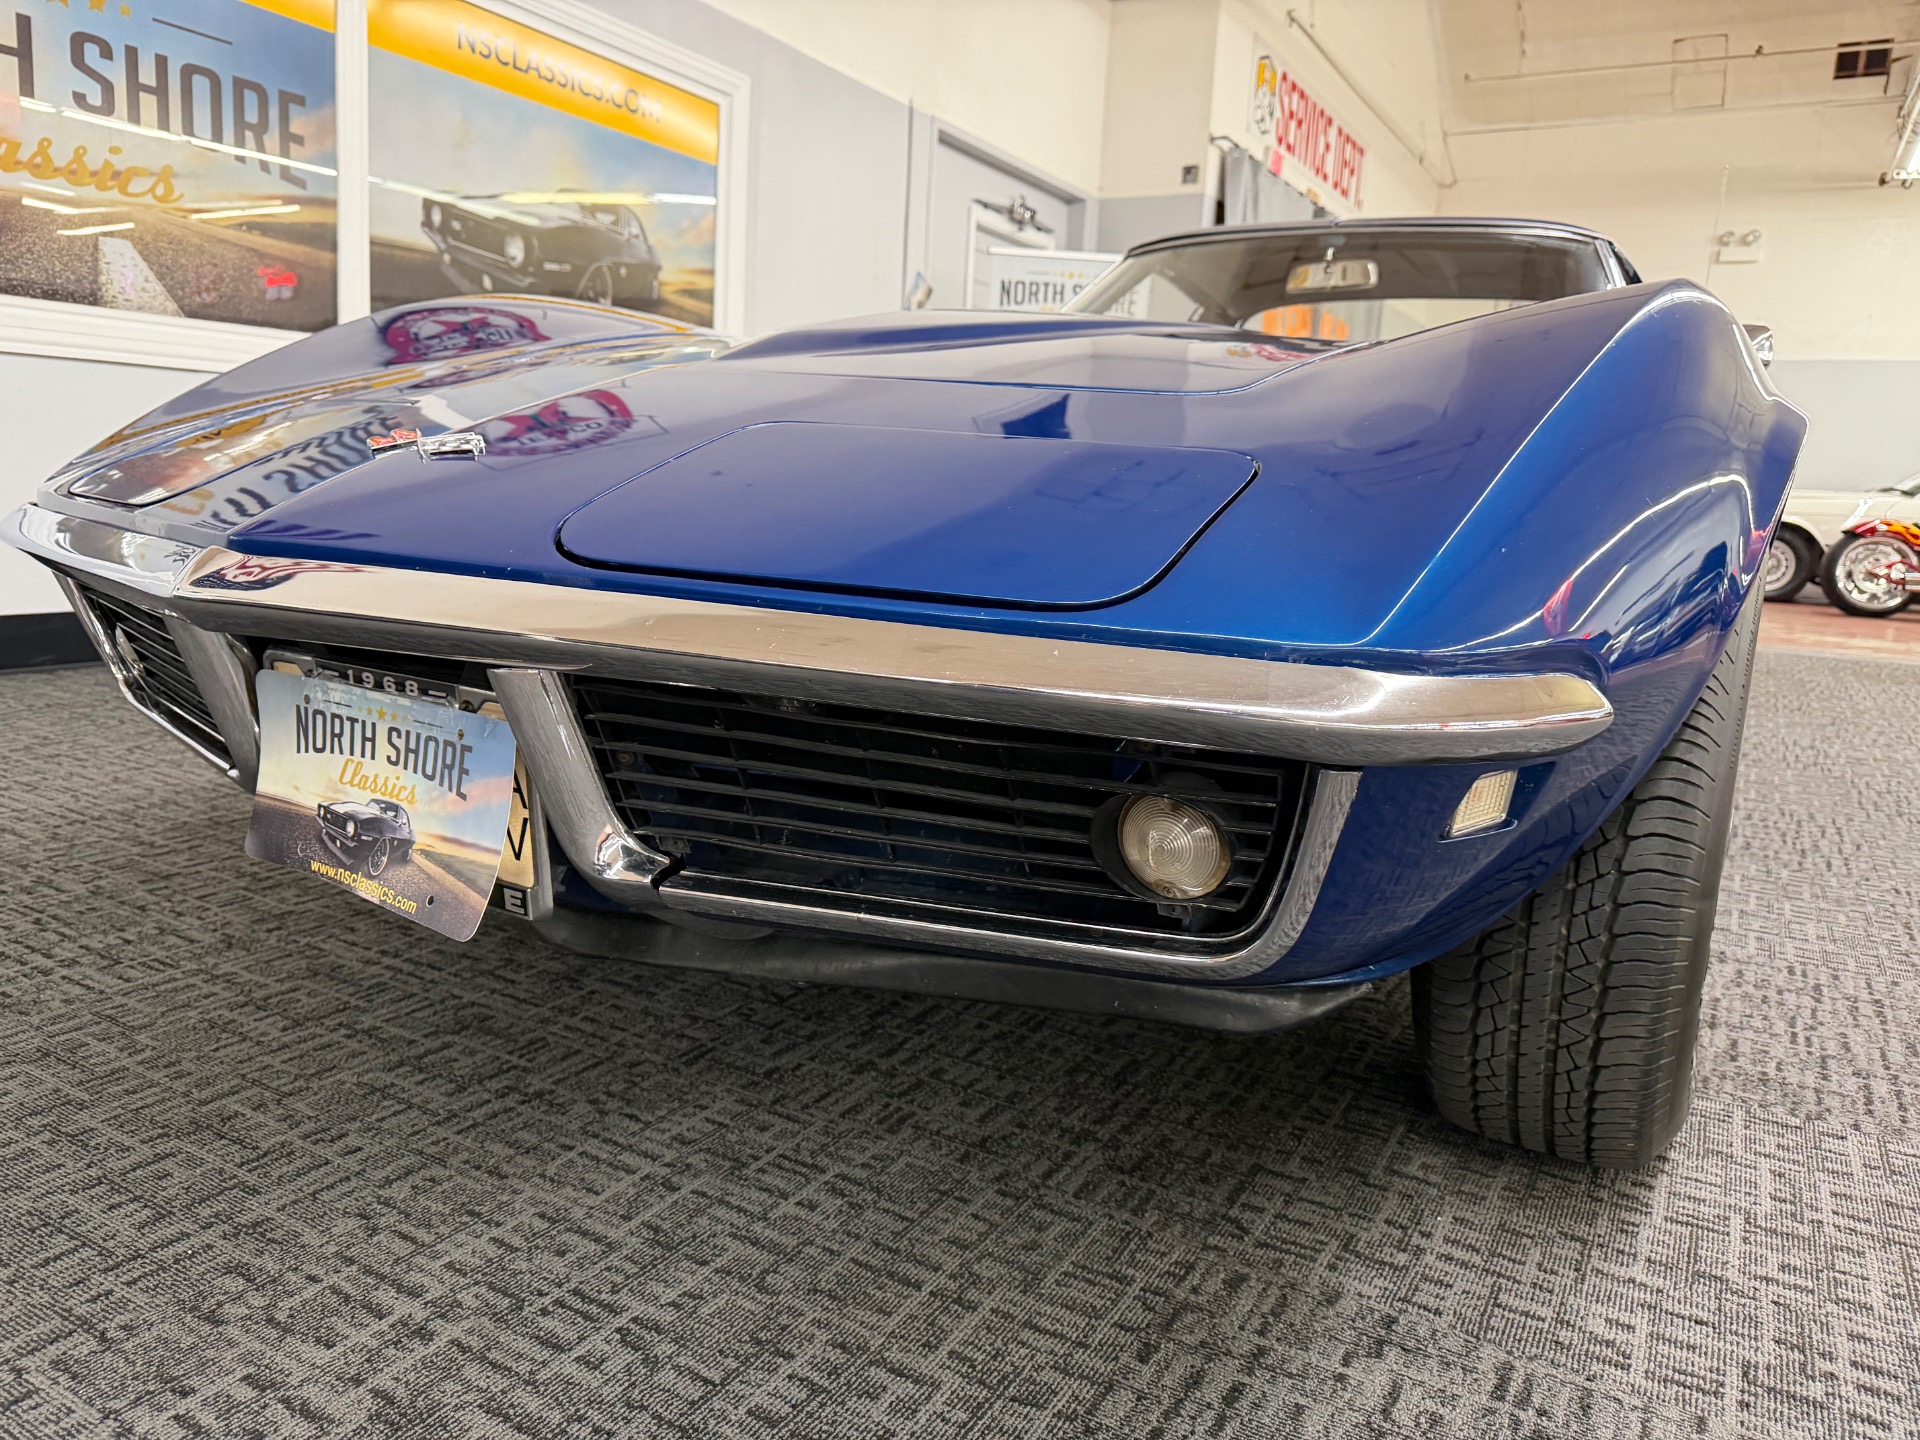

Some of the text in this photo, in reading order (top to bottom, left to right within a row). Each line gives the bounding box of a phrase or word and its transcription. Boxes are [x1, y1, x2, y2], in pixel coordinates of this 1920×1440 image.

[69, 30, 308, 191] SHORE
[456, 21, 662, 123] NSCLASSICS.COM
[1275, 71, 1333, 183] SERVICE
[1000, 279, 1065, 307] NORTH
[295, 704, 474, 802] NORTH SHORE
[338, 758, 419, 806] Classics
[310, 860, 418, 915] www.nsclassics.com
